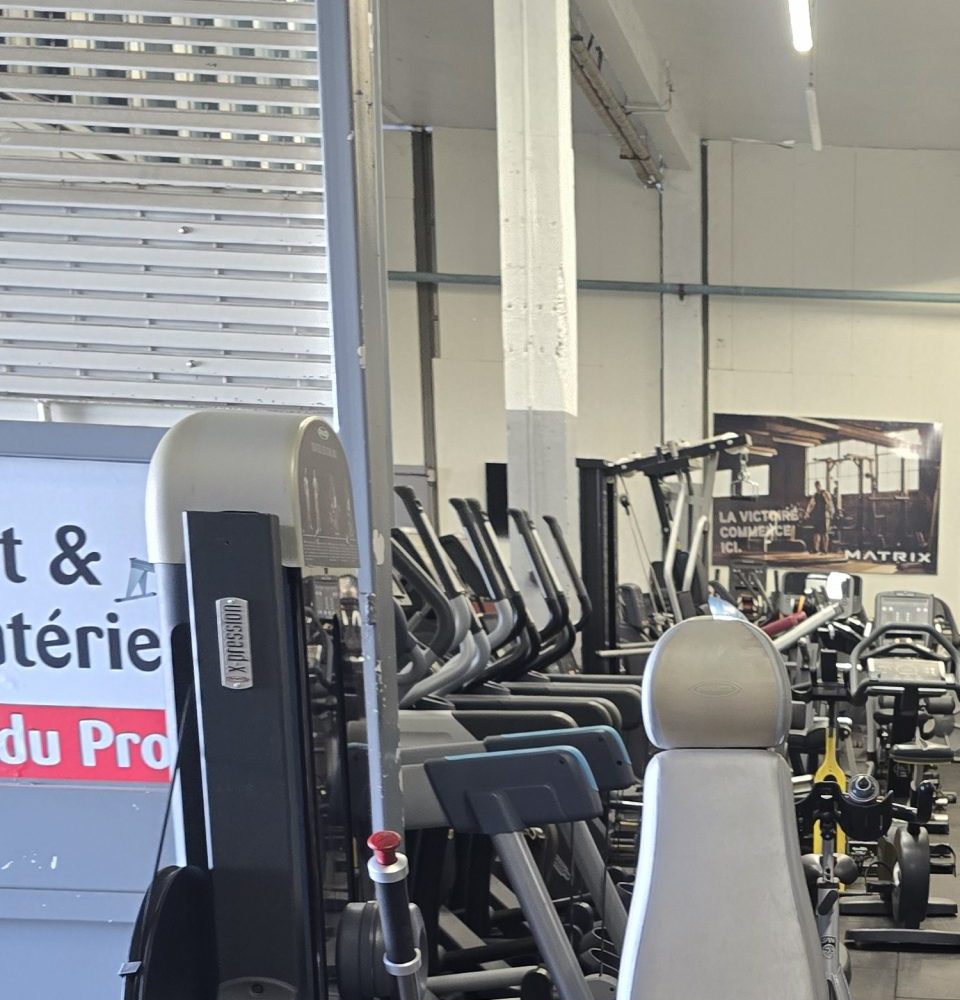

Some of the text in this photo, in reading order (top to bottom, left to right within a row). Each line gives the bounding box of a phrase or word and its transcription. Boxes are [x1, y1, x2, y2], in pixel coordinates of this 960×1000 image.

[719, 509, 800, 523] LA VICTOIRE
[721, 541, 743, 554] ICI.
[50, 524, 102, 586] &
[844, 549, 931, 563] MATRIX
